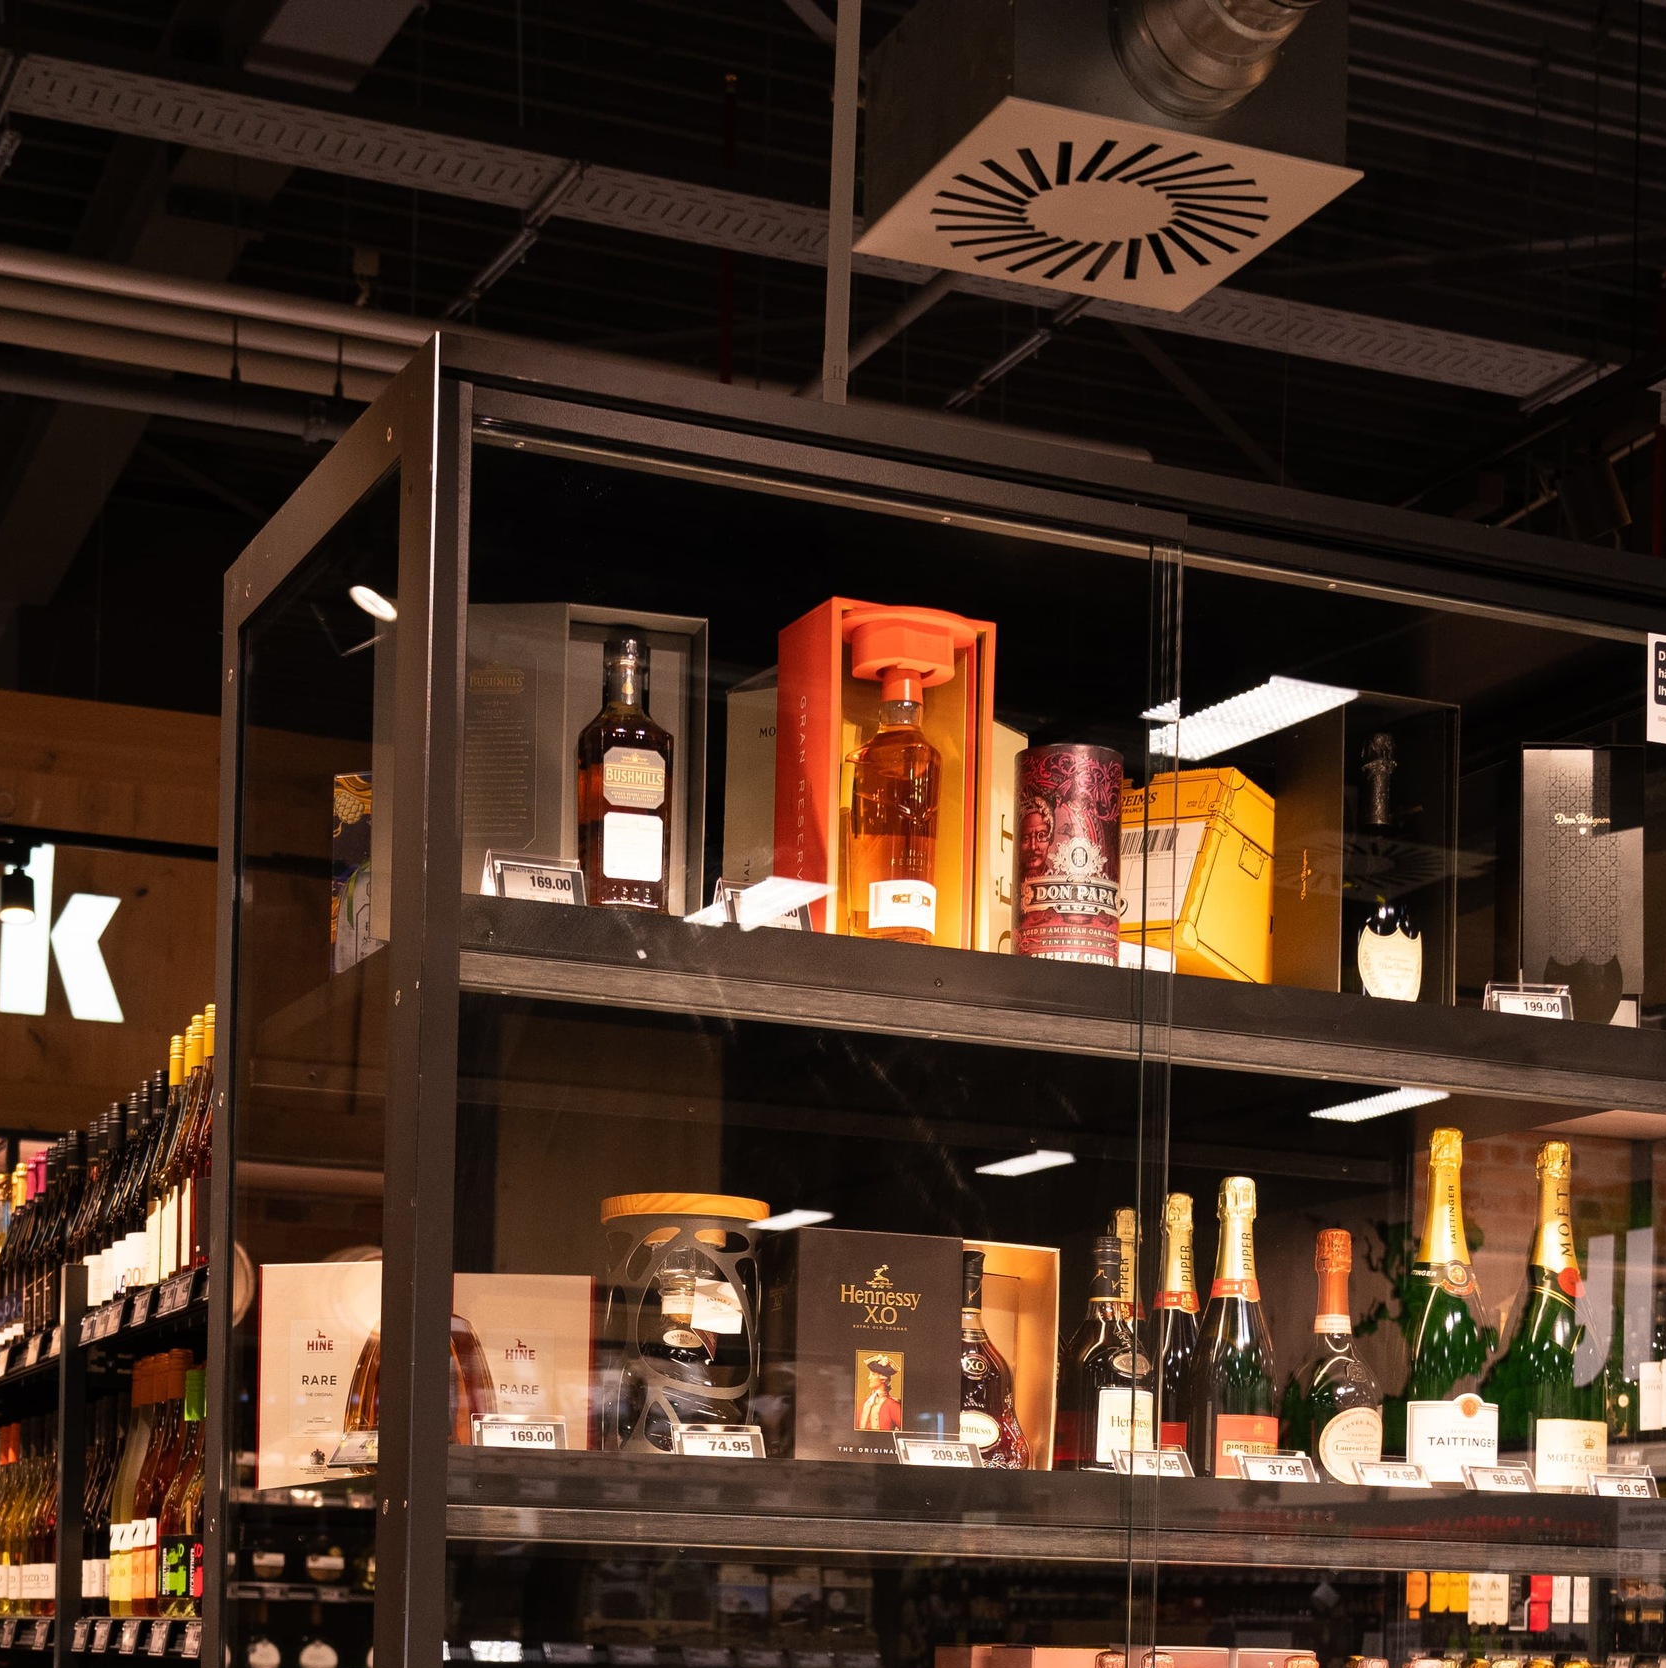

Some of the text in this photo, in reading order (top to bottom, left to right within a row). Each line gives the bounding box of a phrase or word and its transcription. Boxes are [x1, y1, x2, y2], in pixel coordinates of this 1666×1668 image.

[469, 675, 524, 688] BUSHMILLS
[605, 767, 664, 786] BUSHMILLS
[796, 695, 808, 881] GRAN RESERV
[1555, 813, 1611, 827] Dom Pérignon
[530, 875, 572, 892] 169.00
[1036, 885, 1116, 907] DON PAPA
[1048, 926, 1088, 936] AMERICAN
[1088, 928, 1102, 937] OAK
[1041, 939, 1094, 947] FINISHED
[1523, 1001, 1561, 1014] 199.00
[1448, 1185, 1457, 1246] TAITTINGER
[1554, 1188, 1574, 1258] MOËT
[1242, 1231, 1253, 1271] PIPER
[1181, 1244, 1192, 1282] PIPER
[840, 1284, 922, 1311] Hennessy
[306, 1340, 334, 1351] HINE
[505, 1349, 536, 1361] HINE
[301, 1375, 337, 1386] RARE
[499, 1383, 540, 1395] RARE
[961, 1422, 993, 1437] ennessy
[510, 1430, 554, 1443] 169.00
[1427, 1436, 1497, 1448] TAITTINGER
[707, 1440, 751, 1453] 74.95
[931, 1449, 970, 1462] 209.95
[1267, 1463, 1304, 1477] 37.95
[1383, 1469, 1419, 1482] 74.95
[1493, 1474, 1526, 1487] 99.95
[1616, 1483, 1648, 1497] 99.95
